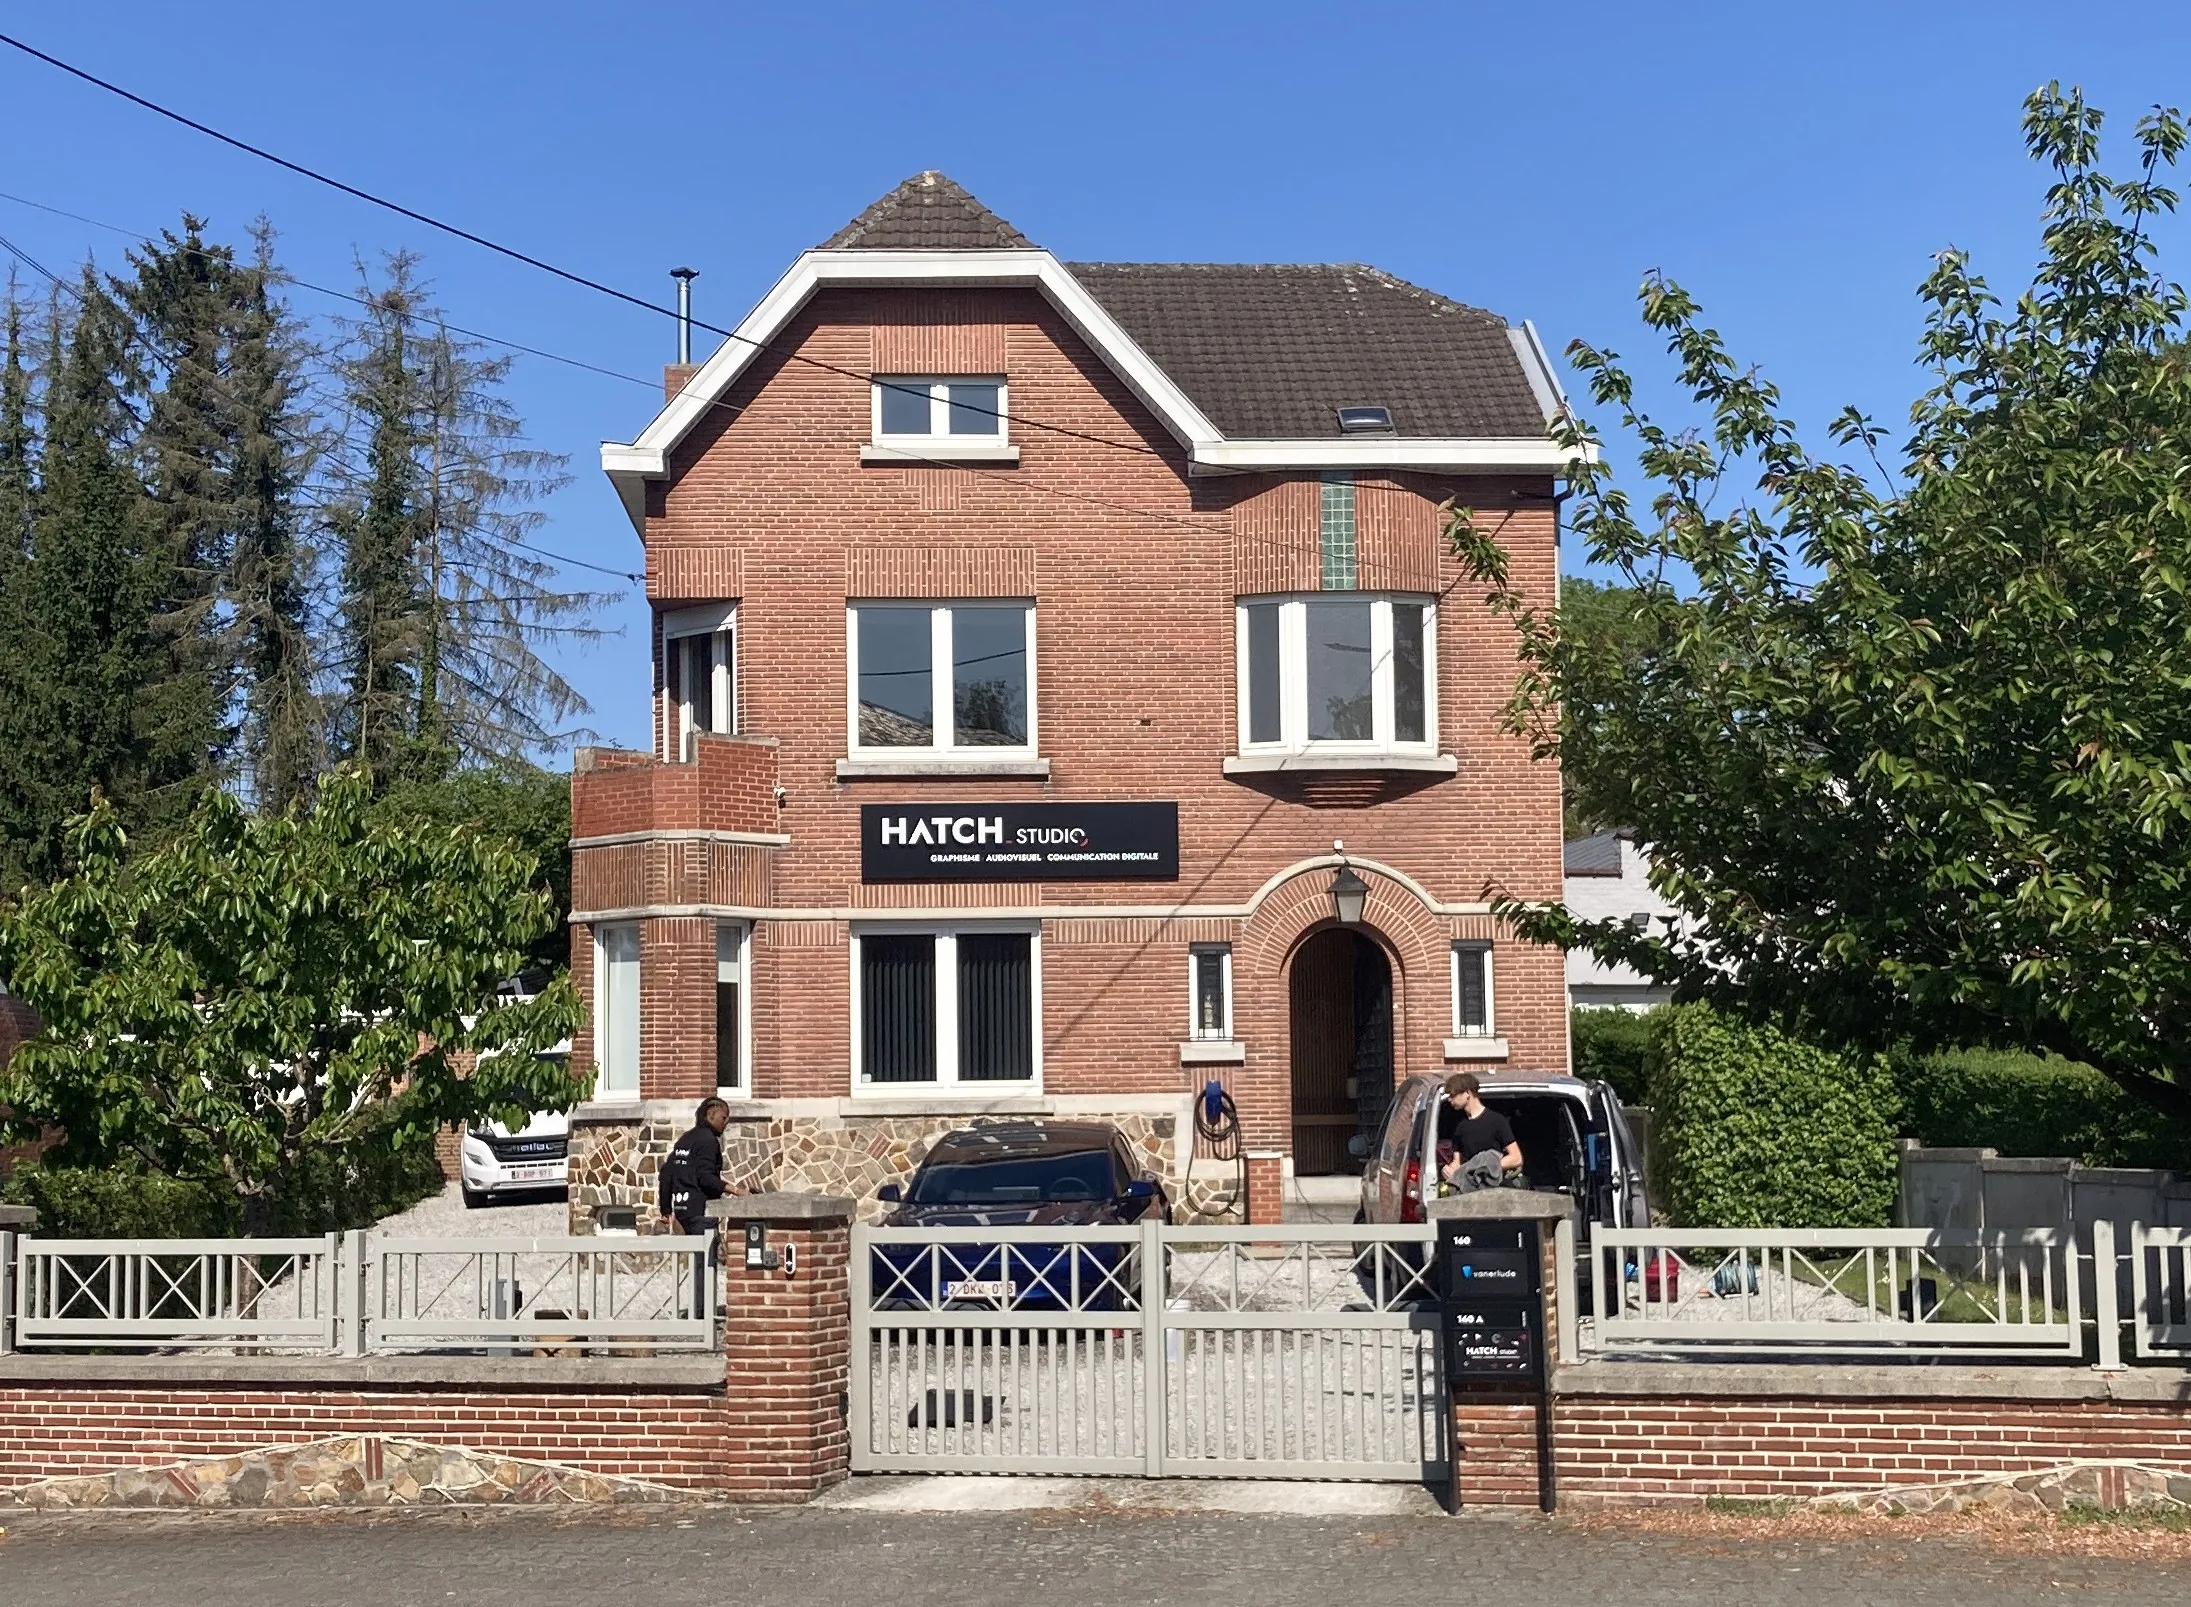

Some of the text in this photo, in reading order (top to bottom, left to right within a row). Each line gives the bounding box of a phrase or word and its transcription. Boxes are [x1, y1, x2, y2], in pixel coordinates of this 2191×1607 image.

[1016, 828, 1087, 846] STUDIO
[930, 852, 1159, 862] GRAPHISME AUDIOVISUEL COMMUNICATION DIGITALE
[1453, 1235, 1471, 1245] 160
[1457, 1314, 1484, 1324] 160 A
